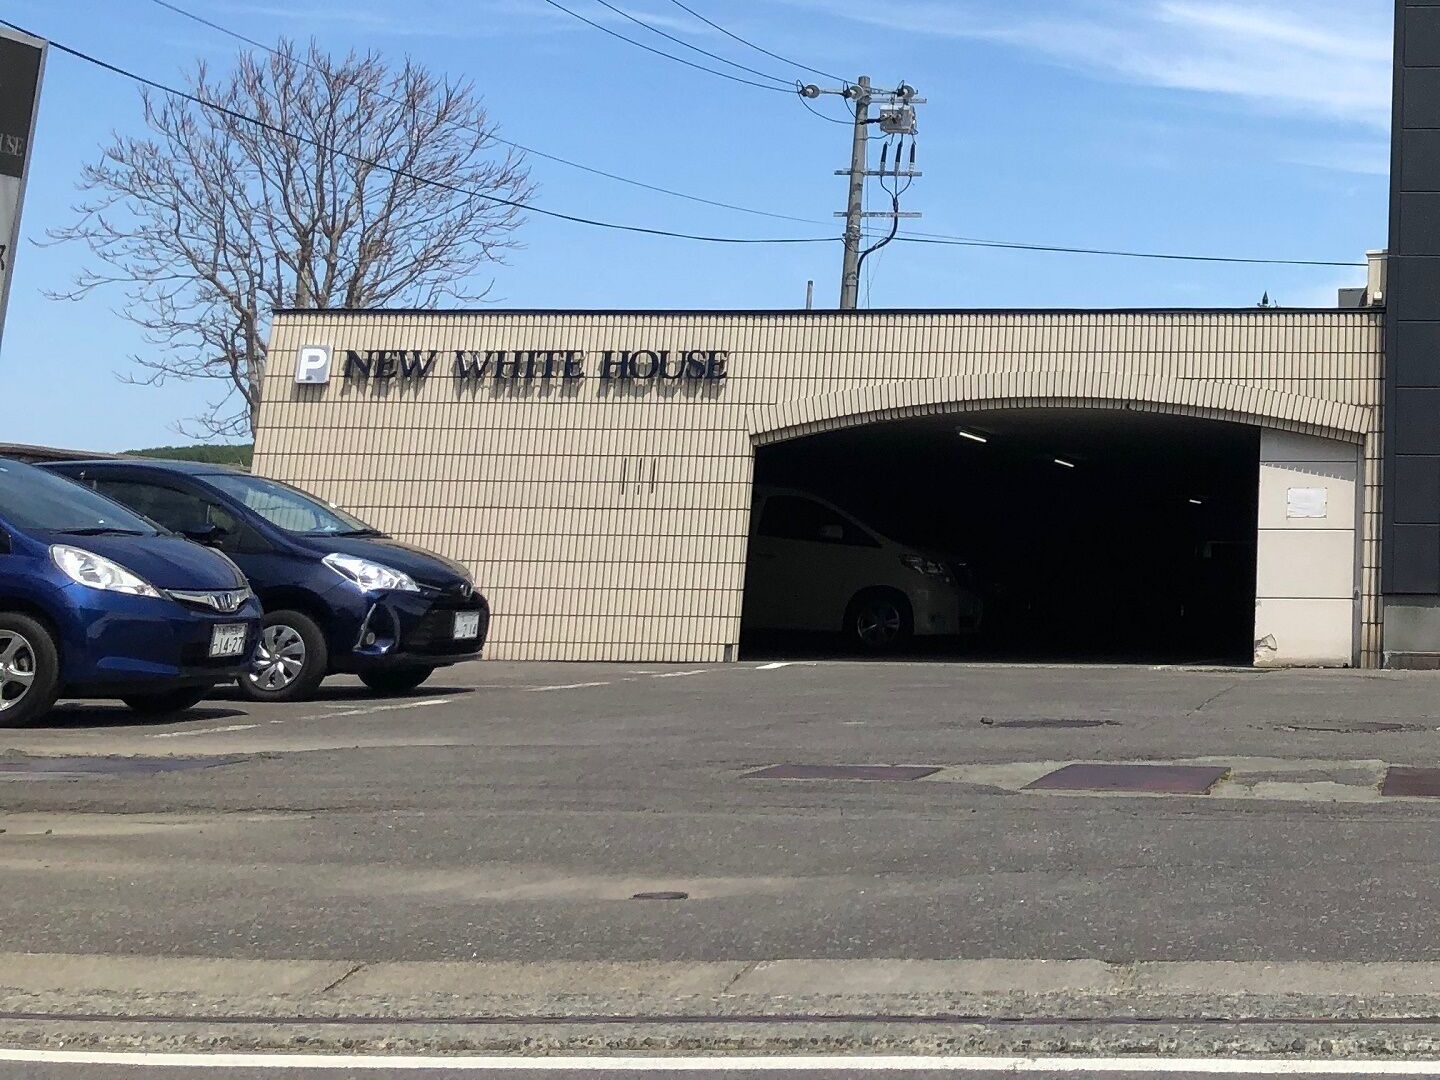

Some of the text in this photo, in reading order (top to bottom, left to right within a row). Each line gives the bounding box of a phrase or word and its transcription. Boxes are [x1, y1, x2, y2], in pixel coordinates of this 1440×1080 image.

[299, 348, 729, 380] P NEW WHITE HOUSE
